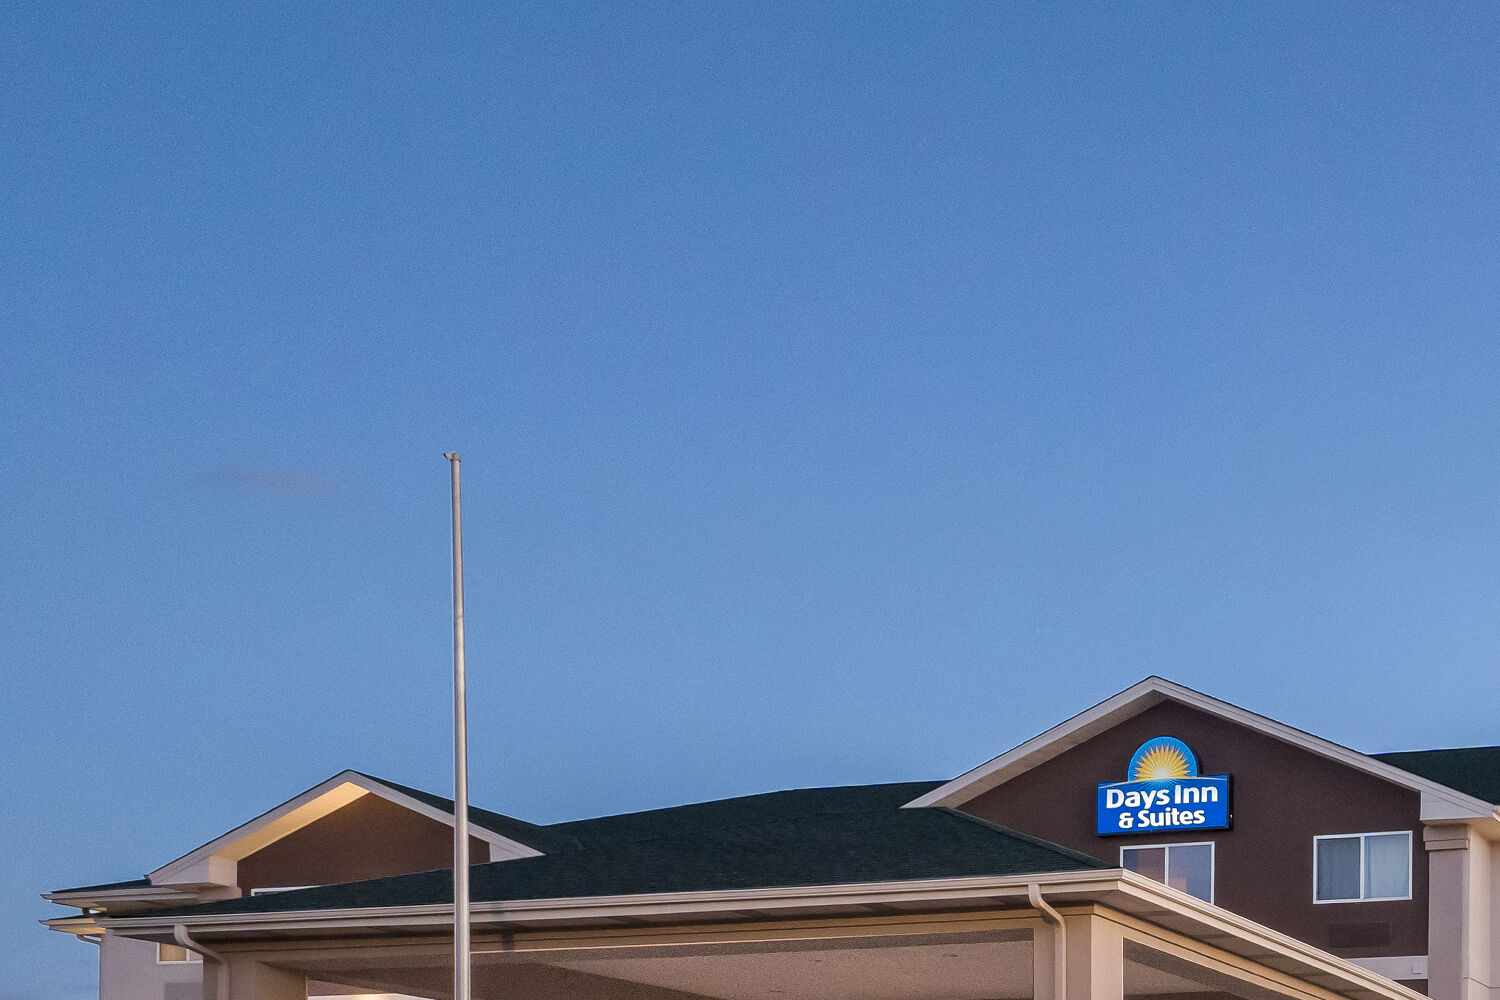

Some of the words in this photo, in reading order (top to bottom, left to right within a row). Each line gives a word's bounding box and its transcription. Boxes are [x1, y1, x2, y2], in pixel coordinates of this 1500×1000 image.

[1106, 788, 1170, 809] Days
[1174, 784, 1218, 804] Inn
[1118, 812, 1134, 829] &
[1137, 807, 1206, 827] Suites
